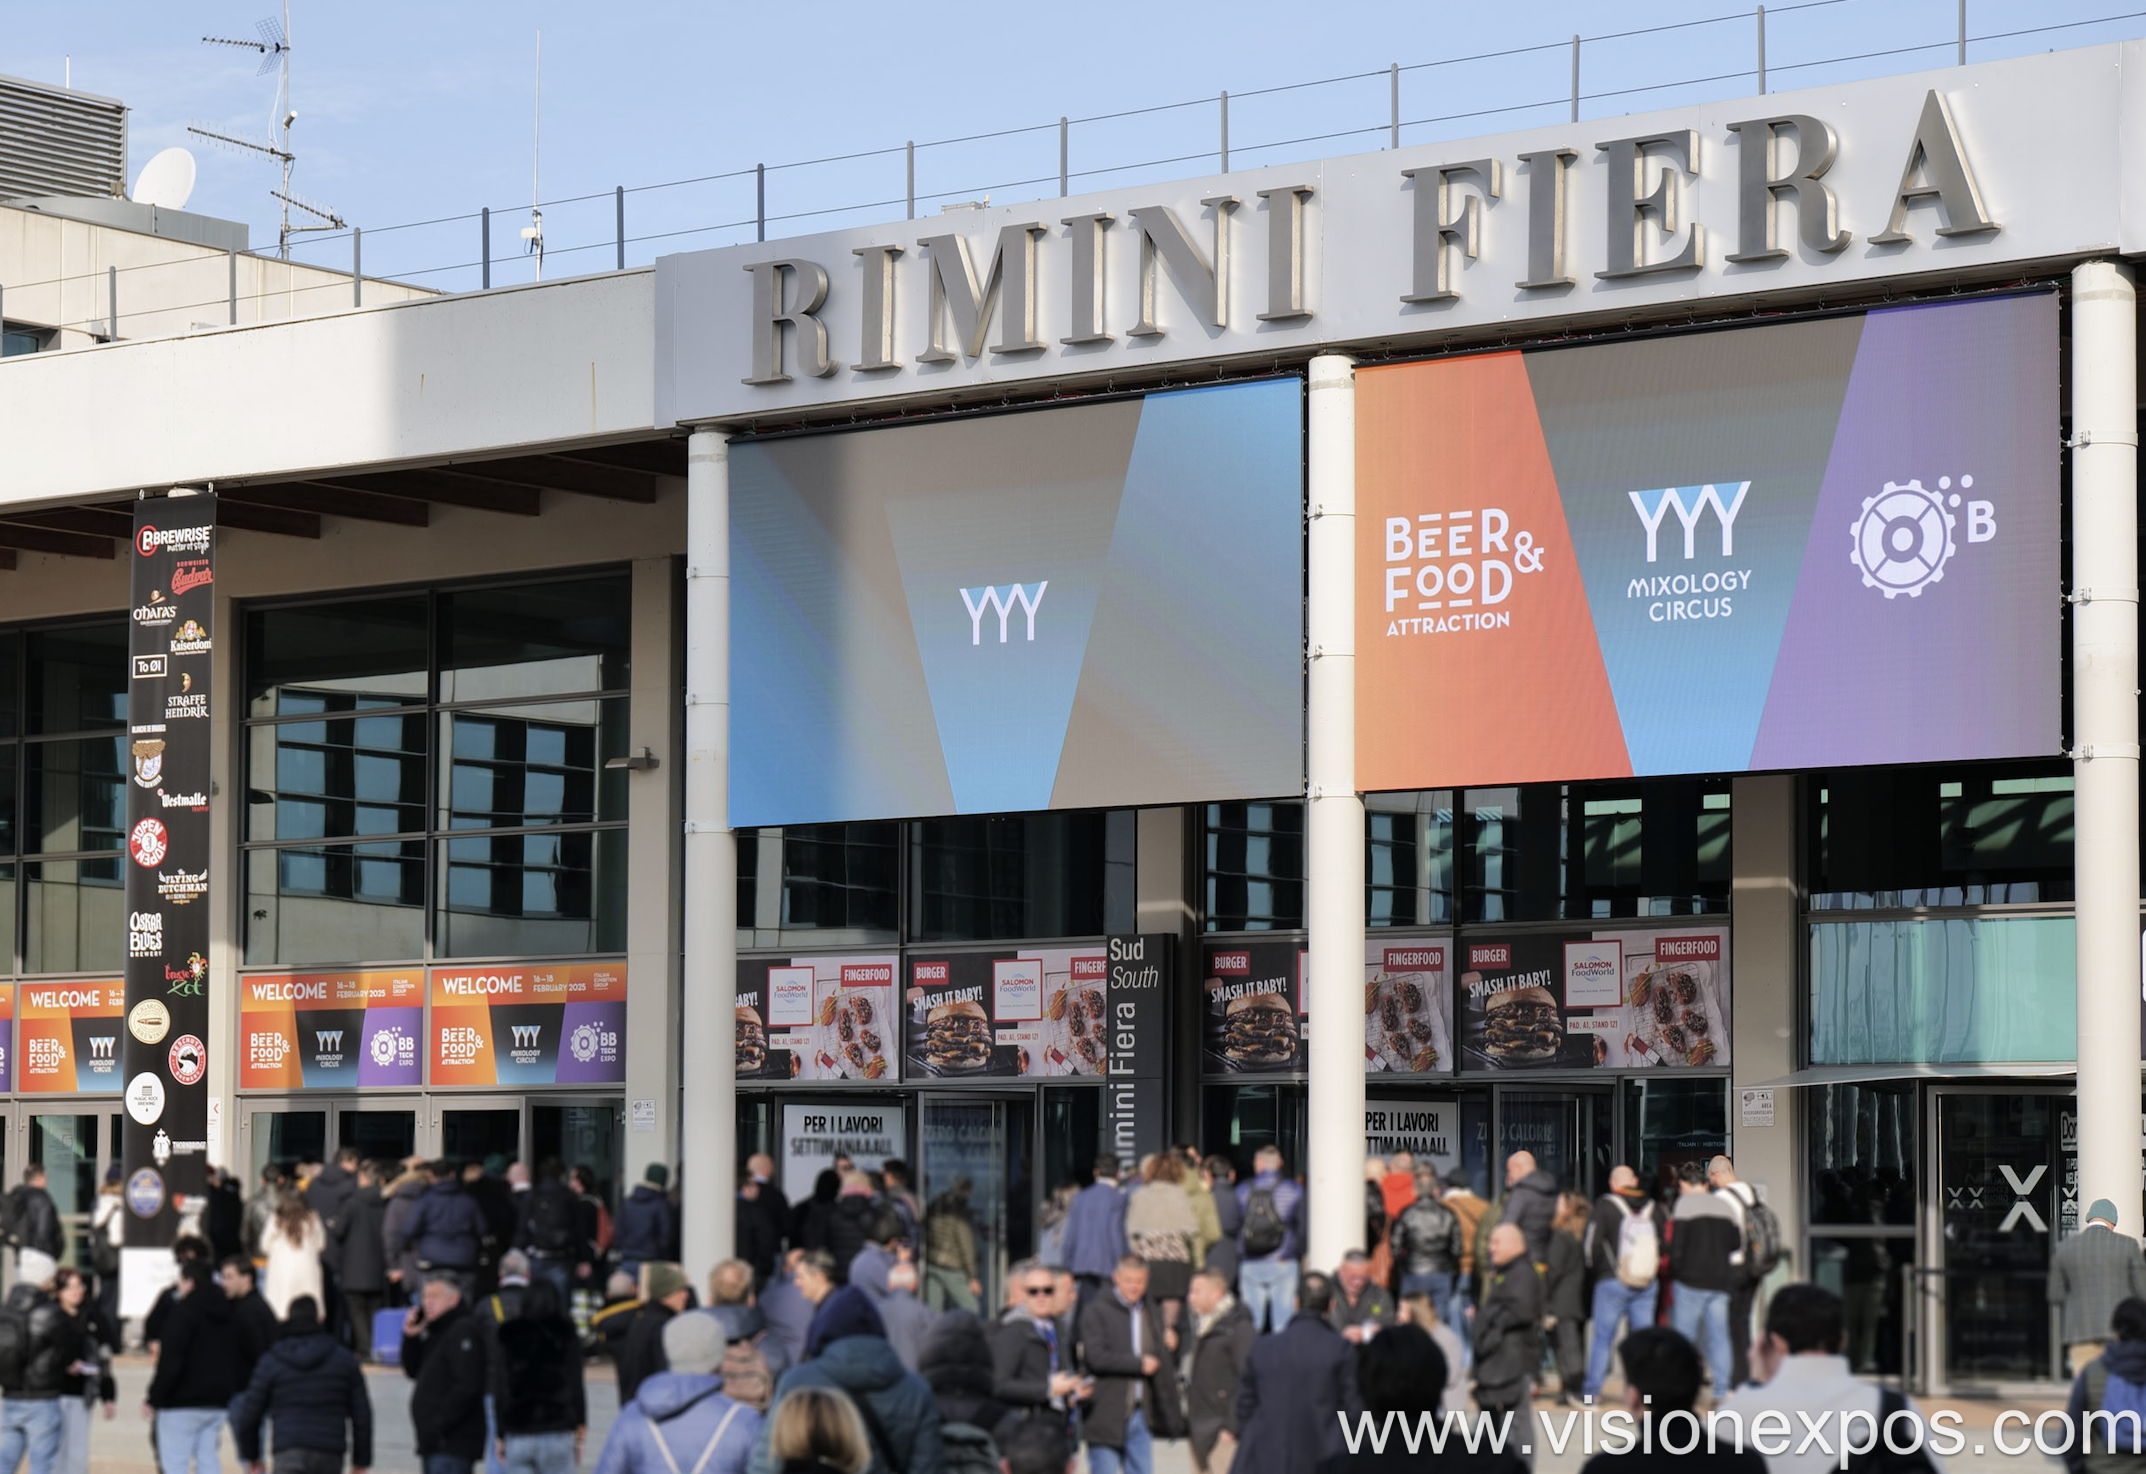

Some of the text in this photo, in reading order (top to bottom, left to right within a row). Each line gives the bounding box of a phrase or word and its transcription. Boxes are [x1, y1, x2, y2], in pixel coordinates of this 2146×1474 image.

[741, 89, 2002, 386] RIMINI FIERA
[151, 526, 211, 545] BREWRISE
[1385, 508, 1510, 562] BEER
[1385, 559, 1513, 613] FOOD
[1627, 569, 1752, 598] MIXOLOGY
[1648, 597, 1733, 622] CIRCUS
[1386, 610, 1510, 637] ATTRACTION
[170, 638, 212, 652] Kaiserdom
[138, 661, 149, 673] To
[167, 694, 206, 707] STRAFFE
[165, 703, 209, 719] HENDRIK
[161, 792, 207, 808] Westmalle
[131, 818, 164, 843] JOPEN
[165, 874, 200, 885] FLYING
[158, 883, 208, 894] DUTCHMAN
[130, 911, 163, 932] OSKAR
[130, 931, 162, 951] BLUES
[1660, 940, 1717, 956] FINGERFOOD
[1109, 938, 1144, 961] Sud
[1472, 949, 1507, 963] BURGER
[1214, 955, 1247, 970] BURGER
[1388, 951, 1441, 966] FINGERFOOD
[1574, 961, 1612, 970] SALOMON
[844, 968, 890, 982] FINGERFOOD
[916, 965, 946, 980] BURGER
[1110, 965, 1159, 989] South
[1572, 968, 1614, 977] FoodWorld
[443, 976, 523, 995] WELCOME
[533, 983, 568, 992] FEBRUARY
[568, 983, 586, 991] 2025
[776, 985, 806, 993] SALOMON
[1000, 984, 1036, 993] FoodWorld
[1002, 978, 1034, 987] SALOMON
[1210, 977, 1287, 1003] SMASH IT BABY!
[1469, 969, 1551, 998] SMASH IT BABY!
[252, 982, 328, 1000] WELCOME
[336, 989, 368, 998] FEBRUARY
[369, 989, 386, 998] 2025
[774, 991, 808, 999] FoodWorld
[913, 985, 984, 1012] SMASH IT BABY!
[30, 990, 100, 1008] WELCOME
[1592, 1021, 1609, 1029] STAND
[1610, 1020, 1618, 1028] 121
[250, 1032, 282, 1047] BEER
[441, 1027, 475, 1042] BEER
[600, 1032, 617, 1047] BB
[1109, 1002, 1135, 1075] Fiera
[29, 1038, 58, 1053] BEER
[398, 1037, 414, 1051] BB
[441, 1043, 476, 1058] FOOD
[29, 1053, 59, 1067] FOOD
[250, 1047, 283, 1062] FOOD
[89, 1059, 116, 1067] MIXOLOGY
[320, 1060, 340, 1068] CIRCUS
[804, 1116, 827, 1133] PER
[838, 1116, 883, 1134] LAVORI
[1365, 1111, 1386, 1131] PER
[1397, 1112, 1439, 1132] LAVORI
